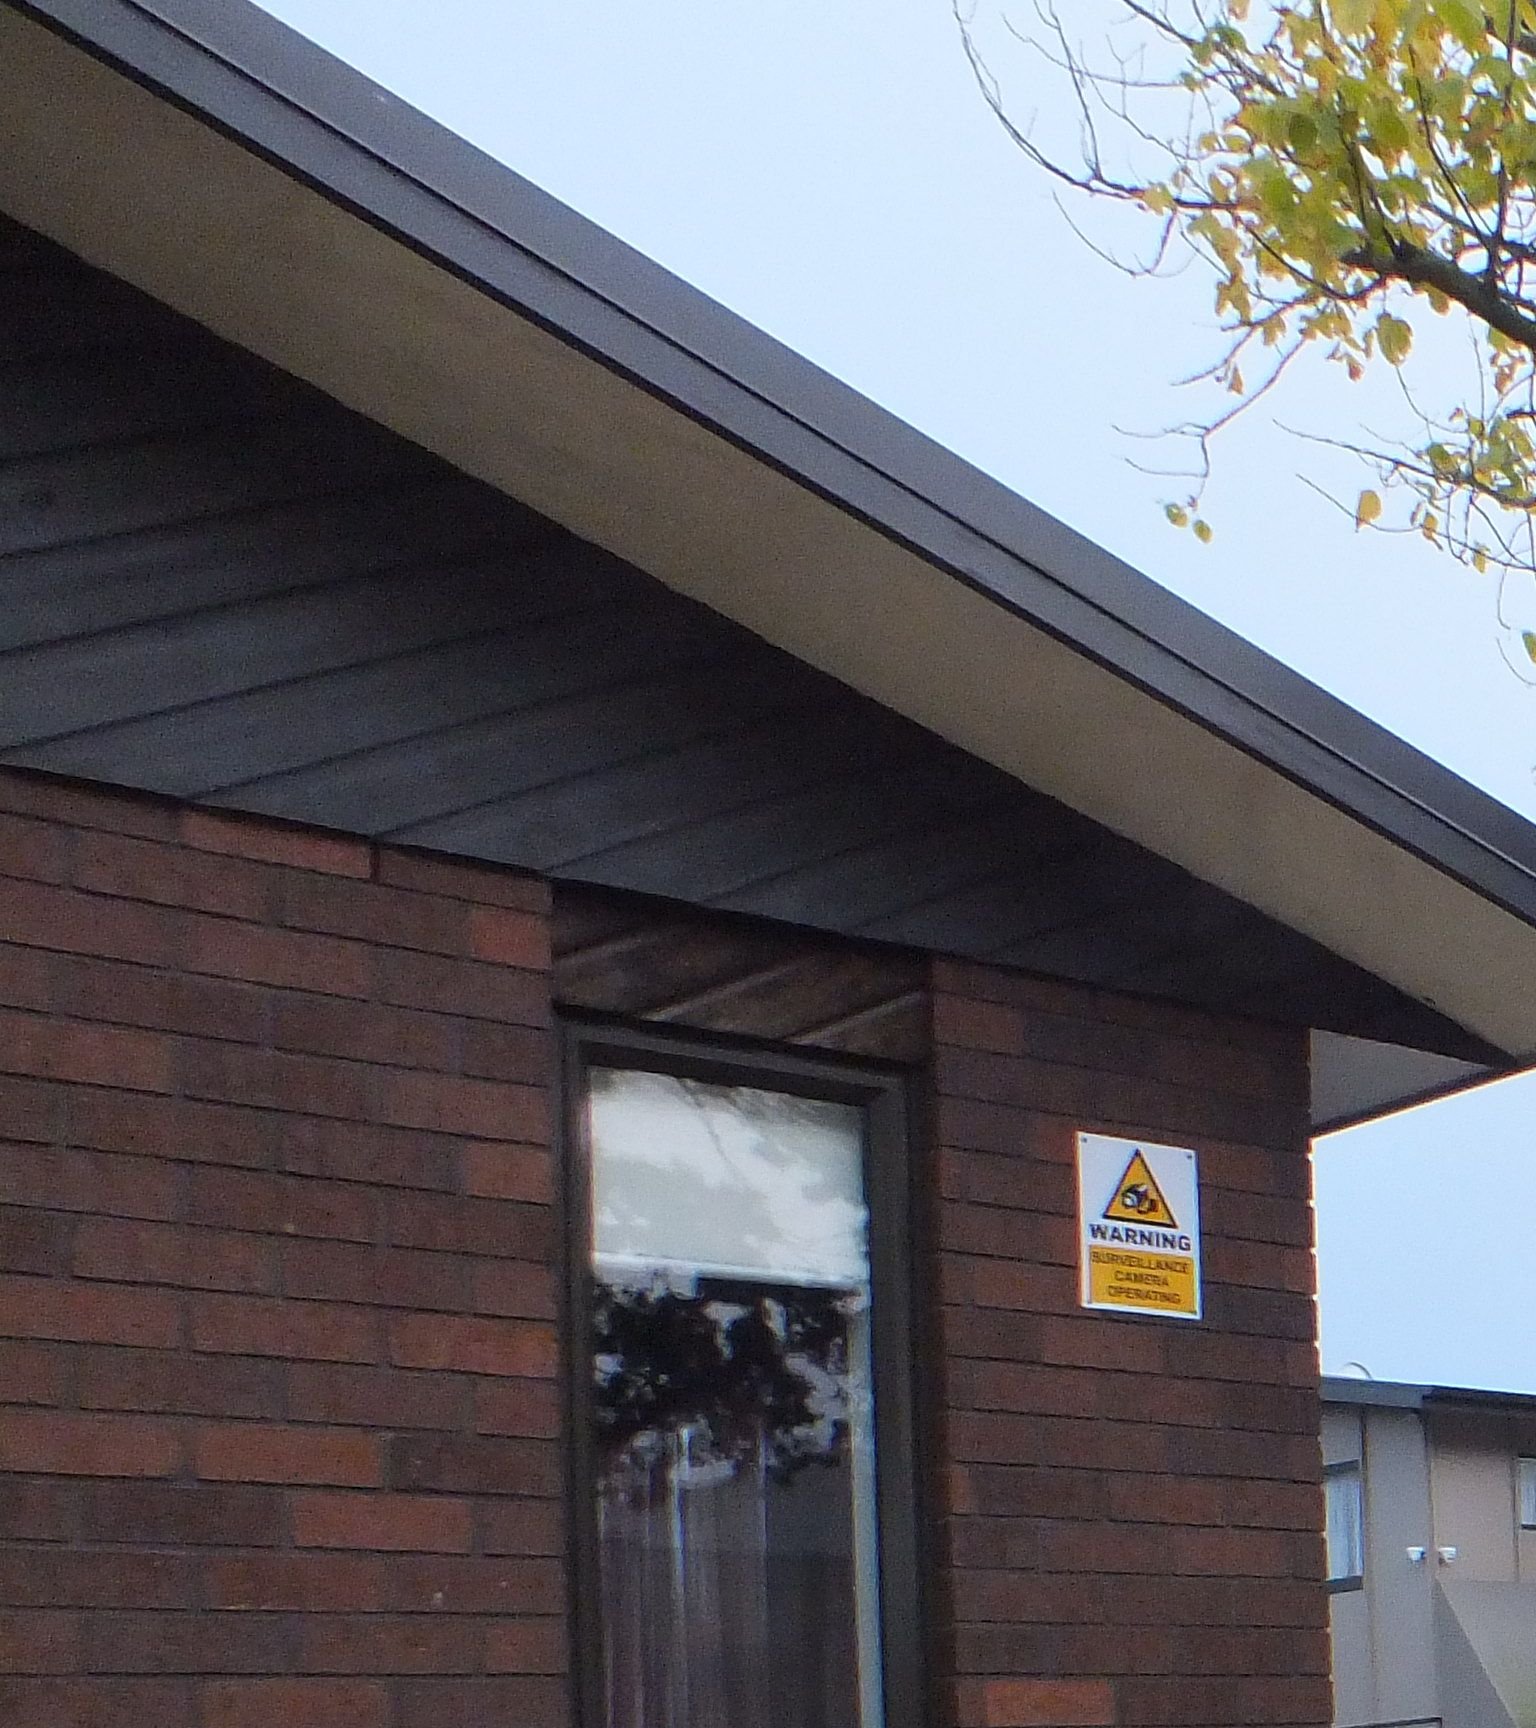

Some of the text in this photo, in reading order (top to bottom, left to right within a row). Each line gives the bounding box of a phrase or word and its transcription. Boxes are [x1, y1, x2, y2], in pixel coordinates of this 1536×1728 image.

[1089, 1223, 1192, 1252] WARNING
[1092, 1250, 1189, 1274] SURVEILLANCE
[1113, 1269, 1169, 1287] CAMERA
[1108, 1285, 1182, 1305] OPERATING
